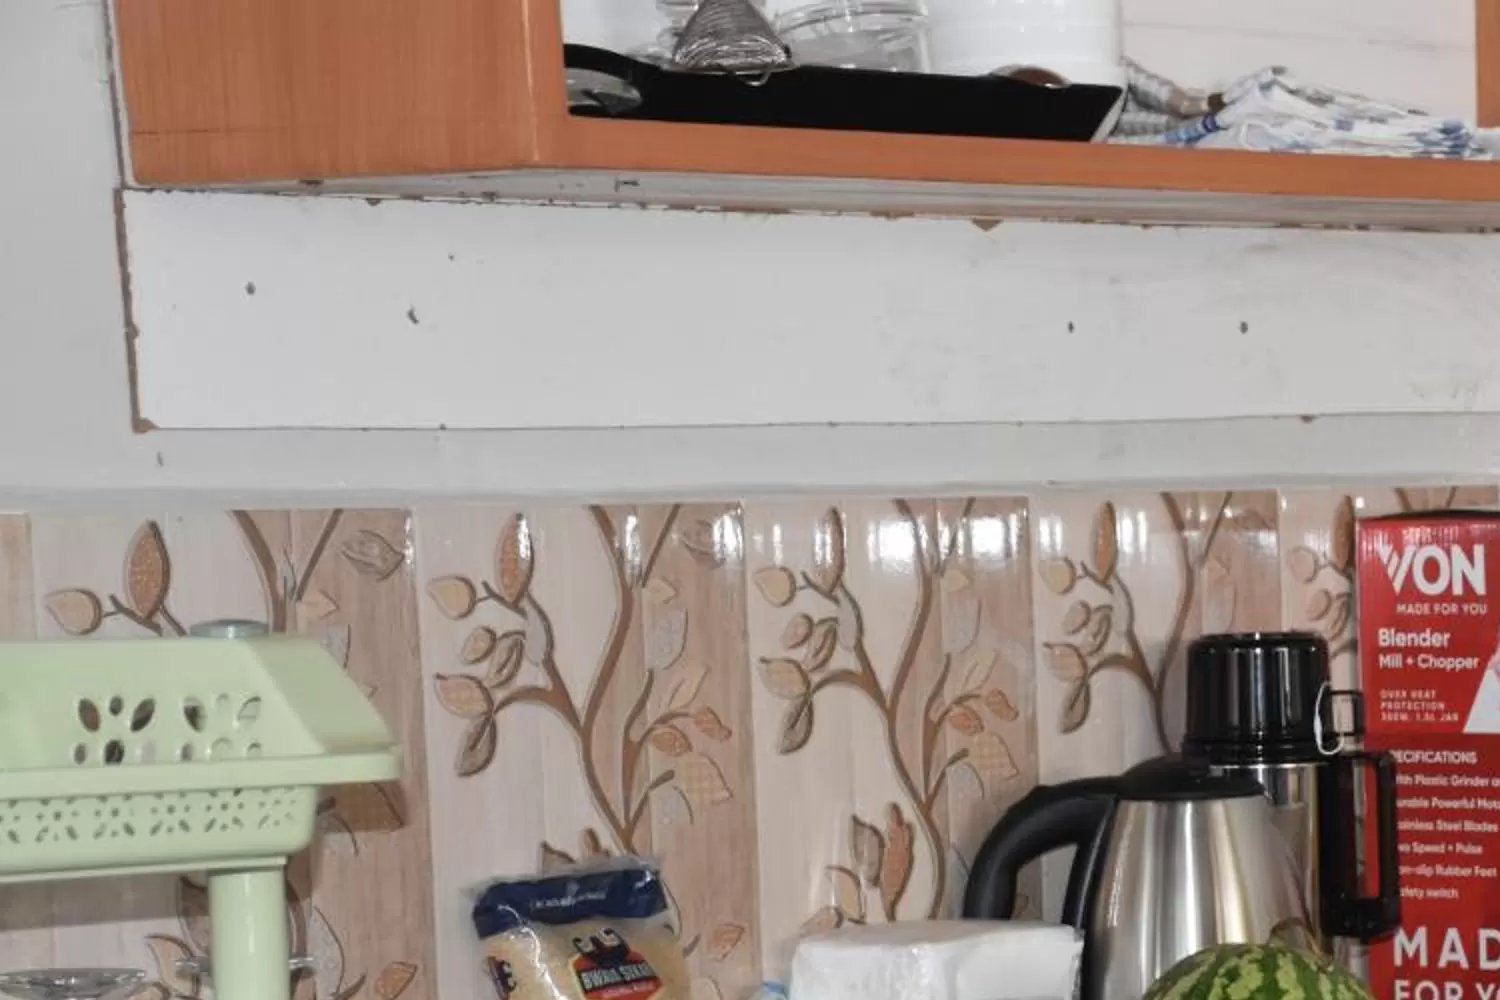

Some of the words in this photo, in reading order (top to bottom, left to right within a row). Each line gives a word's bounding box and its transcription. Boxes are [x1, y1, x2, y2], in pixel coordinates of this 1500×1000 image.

[1375, 542, 1488, 597] VON
[1396, 603, 1431, 616] MADE
[1433, 603, 1459, 615] FOR
[1463, 602, 1488, 615] YOU
[1377, 626, 1451, 648] Blender
[1378, 653, 1403, 669] Mill
[1417, 653, 1480, 672] Chopper
[1380, 689, 1407, 699] OVER
[1380, 701, 1445, 711] PROTECTION
[1389, 750, 1478, 764] PECIFICATIONS
[1395, 773, 1413, 785] ith
[1414, 773, 1448, 786] Plastic
[1450, 774, 1490, 787] Grinder
[1396, 797, 1429, 809] urable
[1431, 797, 1475, 809] Powerful
[1398, 819, 1434, 831] ainless
[1435, 820, 1462, 832] Steel
[1463, 820, 1499, 833] Blades
[1398, 844, 1411, 853] wo
[1412, 842, 1446, 855] Speed
[1455, 842, 1484, 855] Pulse
[1399, 864, 1434, 878] on-slip
[1435, 864, 1473, 877] Rubber
[1474, 865, 1498, 877] Feet
[1399, 887, 1424, 900] afety
[1426, 887, 1459, 900] switch
